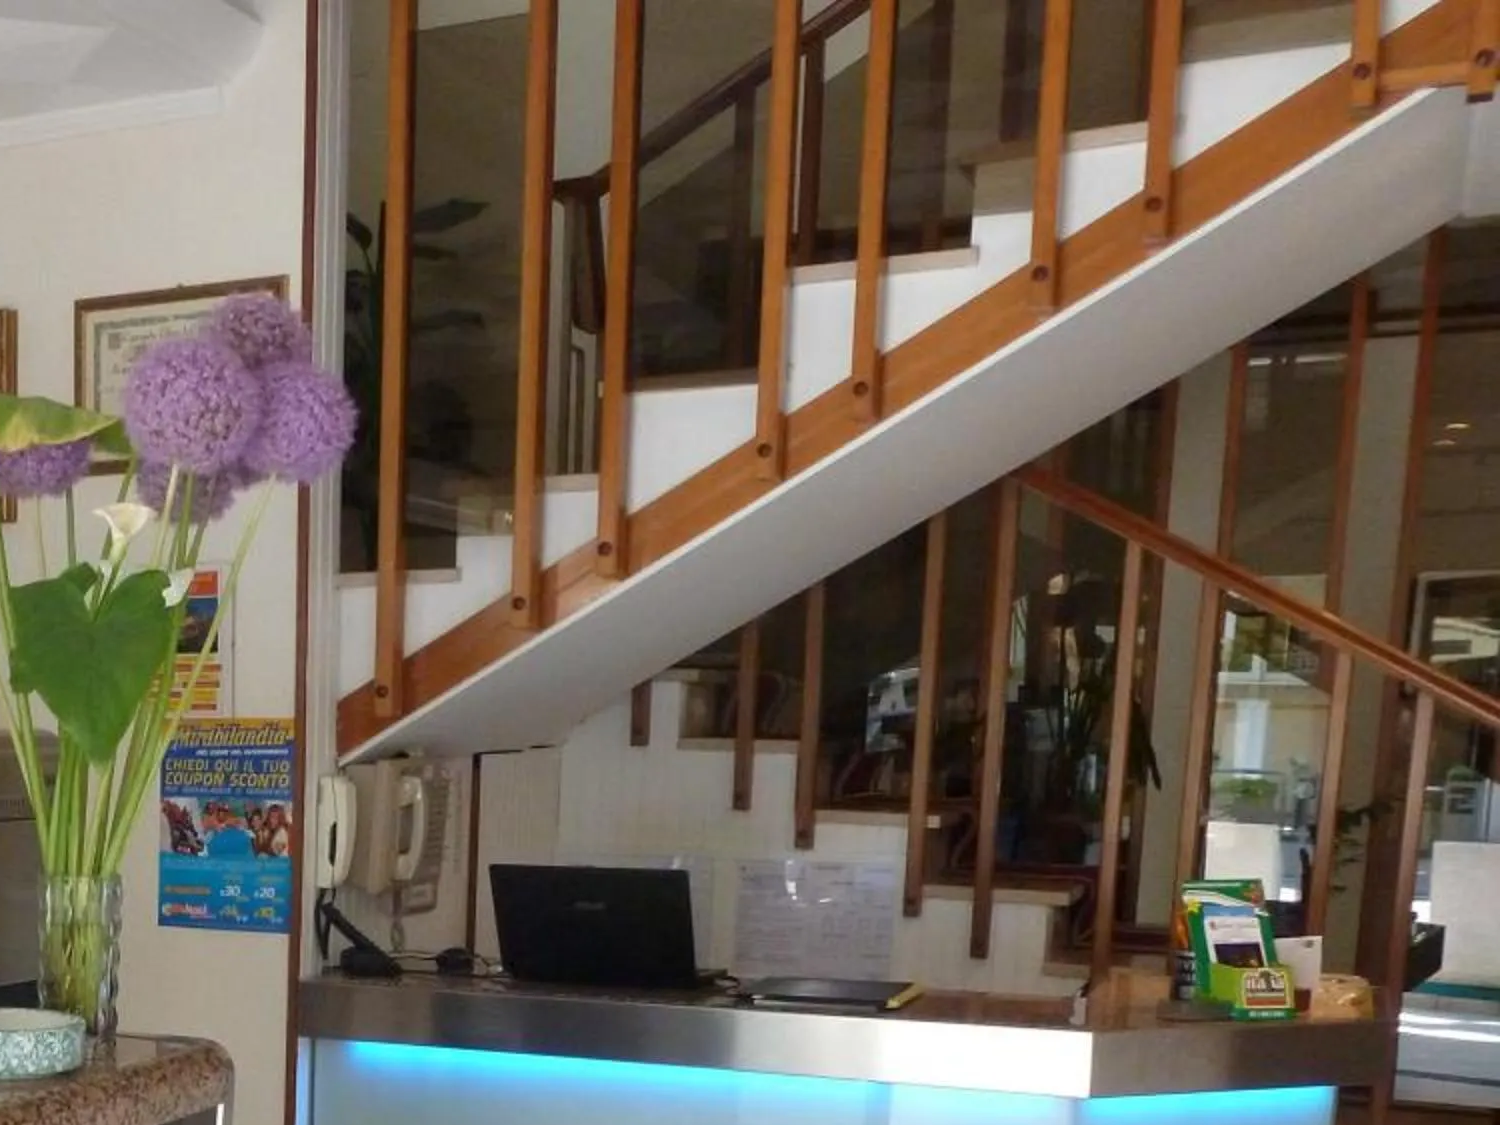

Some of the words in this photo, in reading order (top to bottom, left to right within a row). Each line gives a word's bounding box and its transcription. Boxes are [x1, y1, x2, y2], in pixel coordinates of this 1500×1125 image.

[165, 758, 210, 771] CHIEDI
[214, 758, 240, 772] QUI
[261, 760, 291, 773] TUO
[164, 771, 225, 787] COUPON
[229, 773, 290, 788] SCONTO
